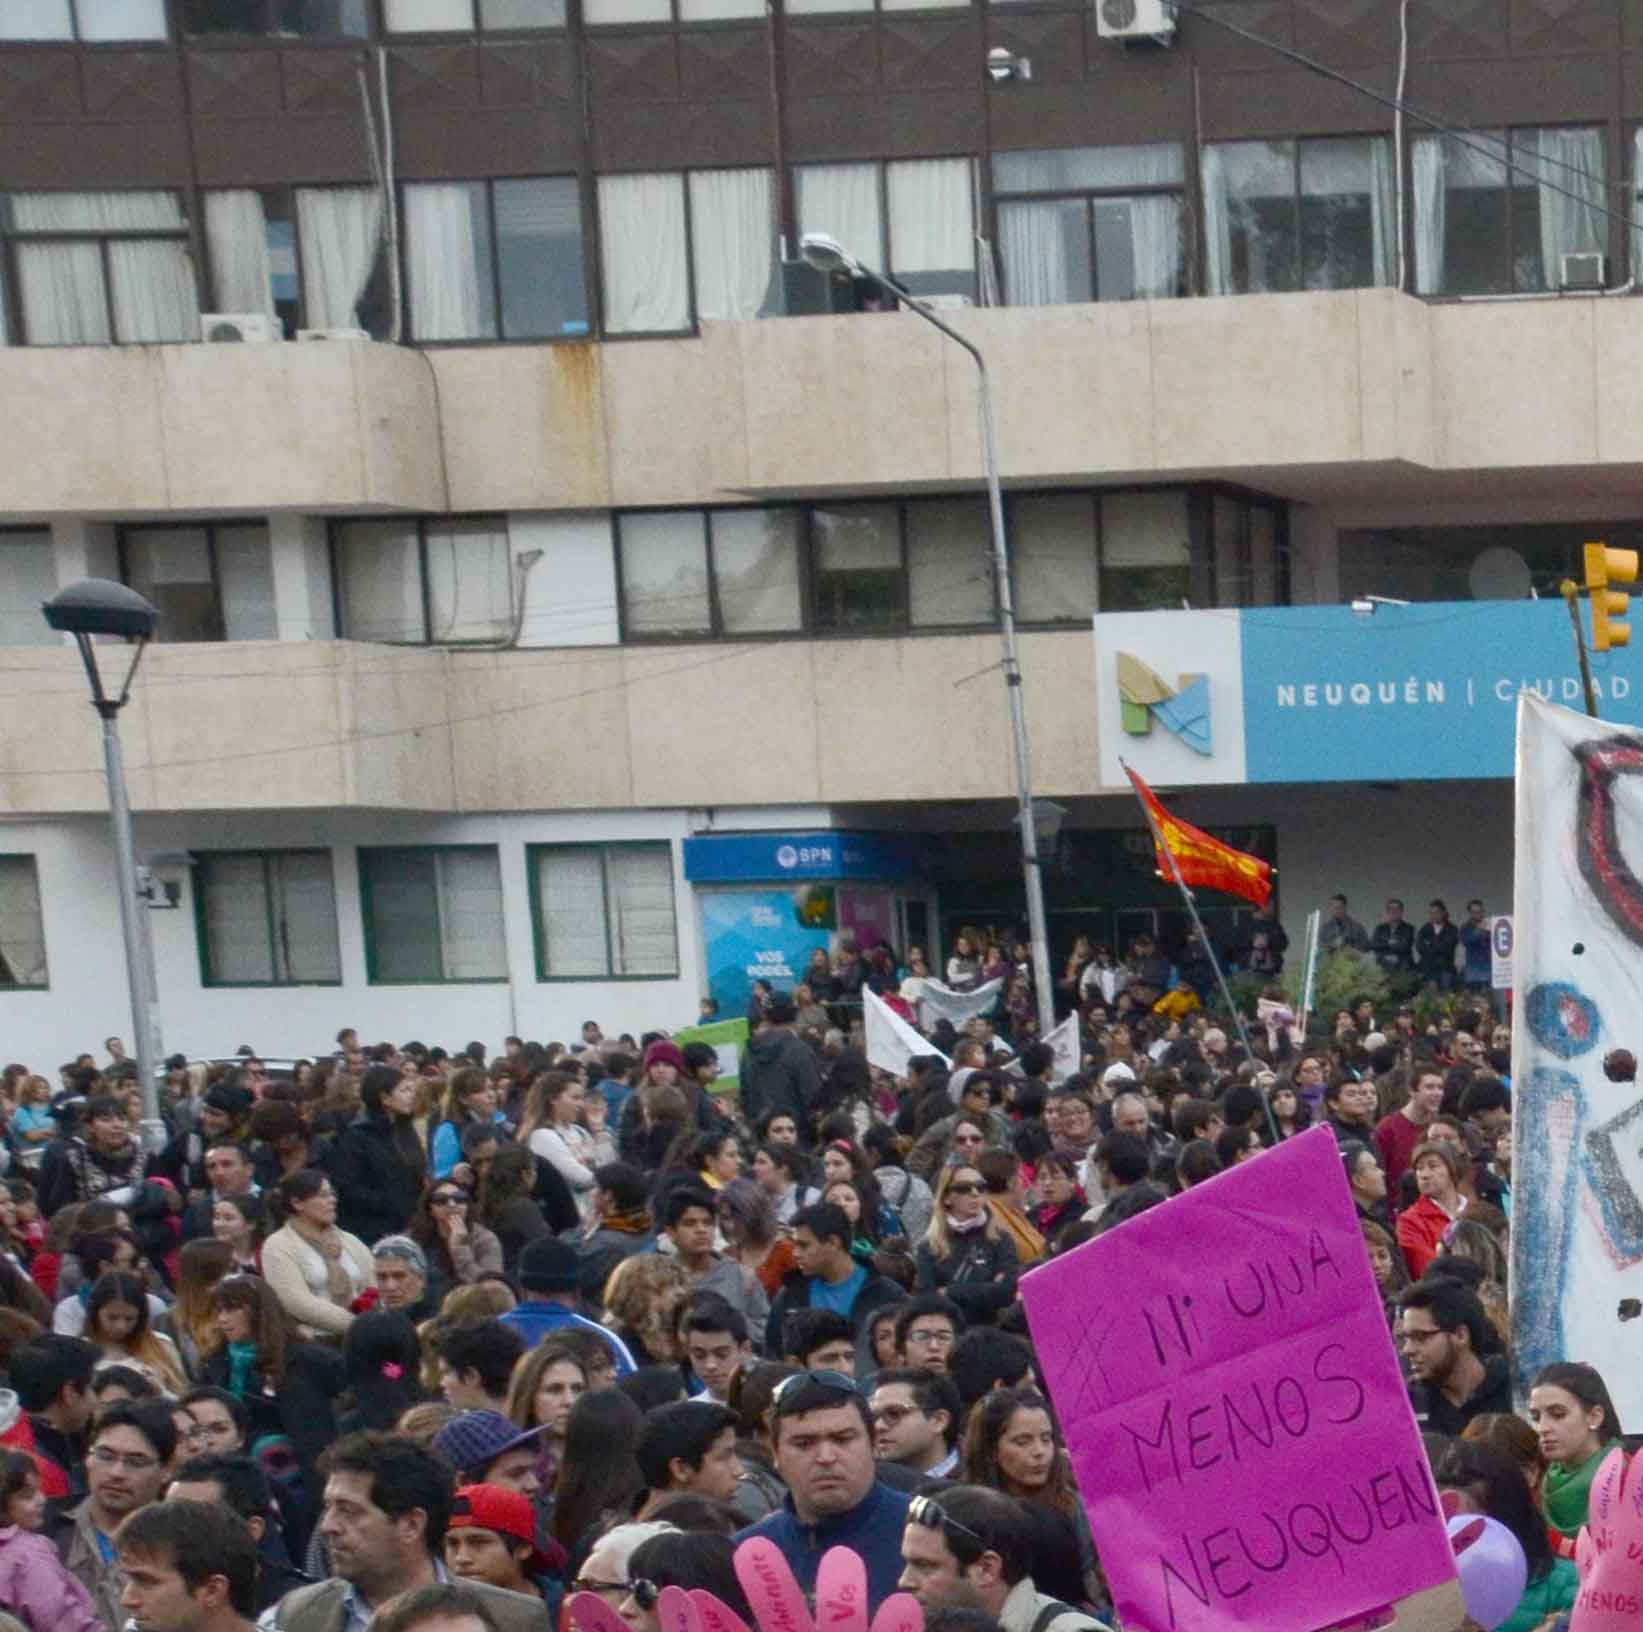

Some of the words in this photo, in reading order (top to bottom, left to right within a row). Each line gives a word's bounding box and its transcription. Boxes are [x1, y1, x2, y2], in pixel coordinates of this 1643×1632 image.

[1277, 677, 1446, 706] NEUQUÉN
[800, 847, 831, 862] BPN
[1223, 1227, 1345, 1319] UNA
[1120, 1342, 1367, 1494] MENOS
[1156, 1457, 1439, 1630] NEUQUEN
